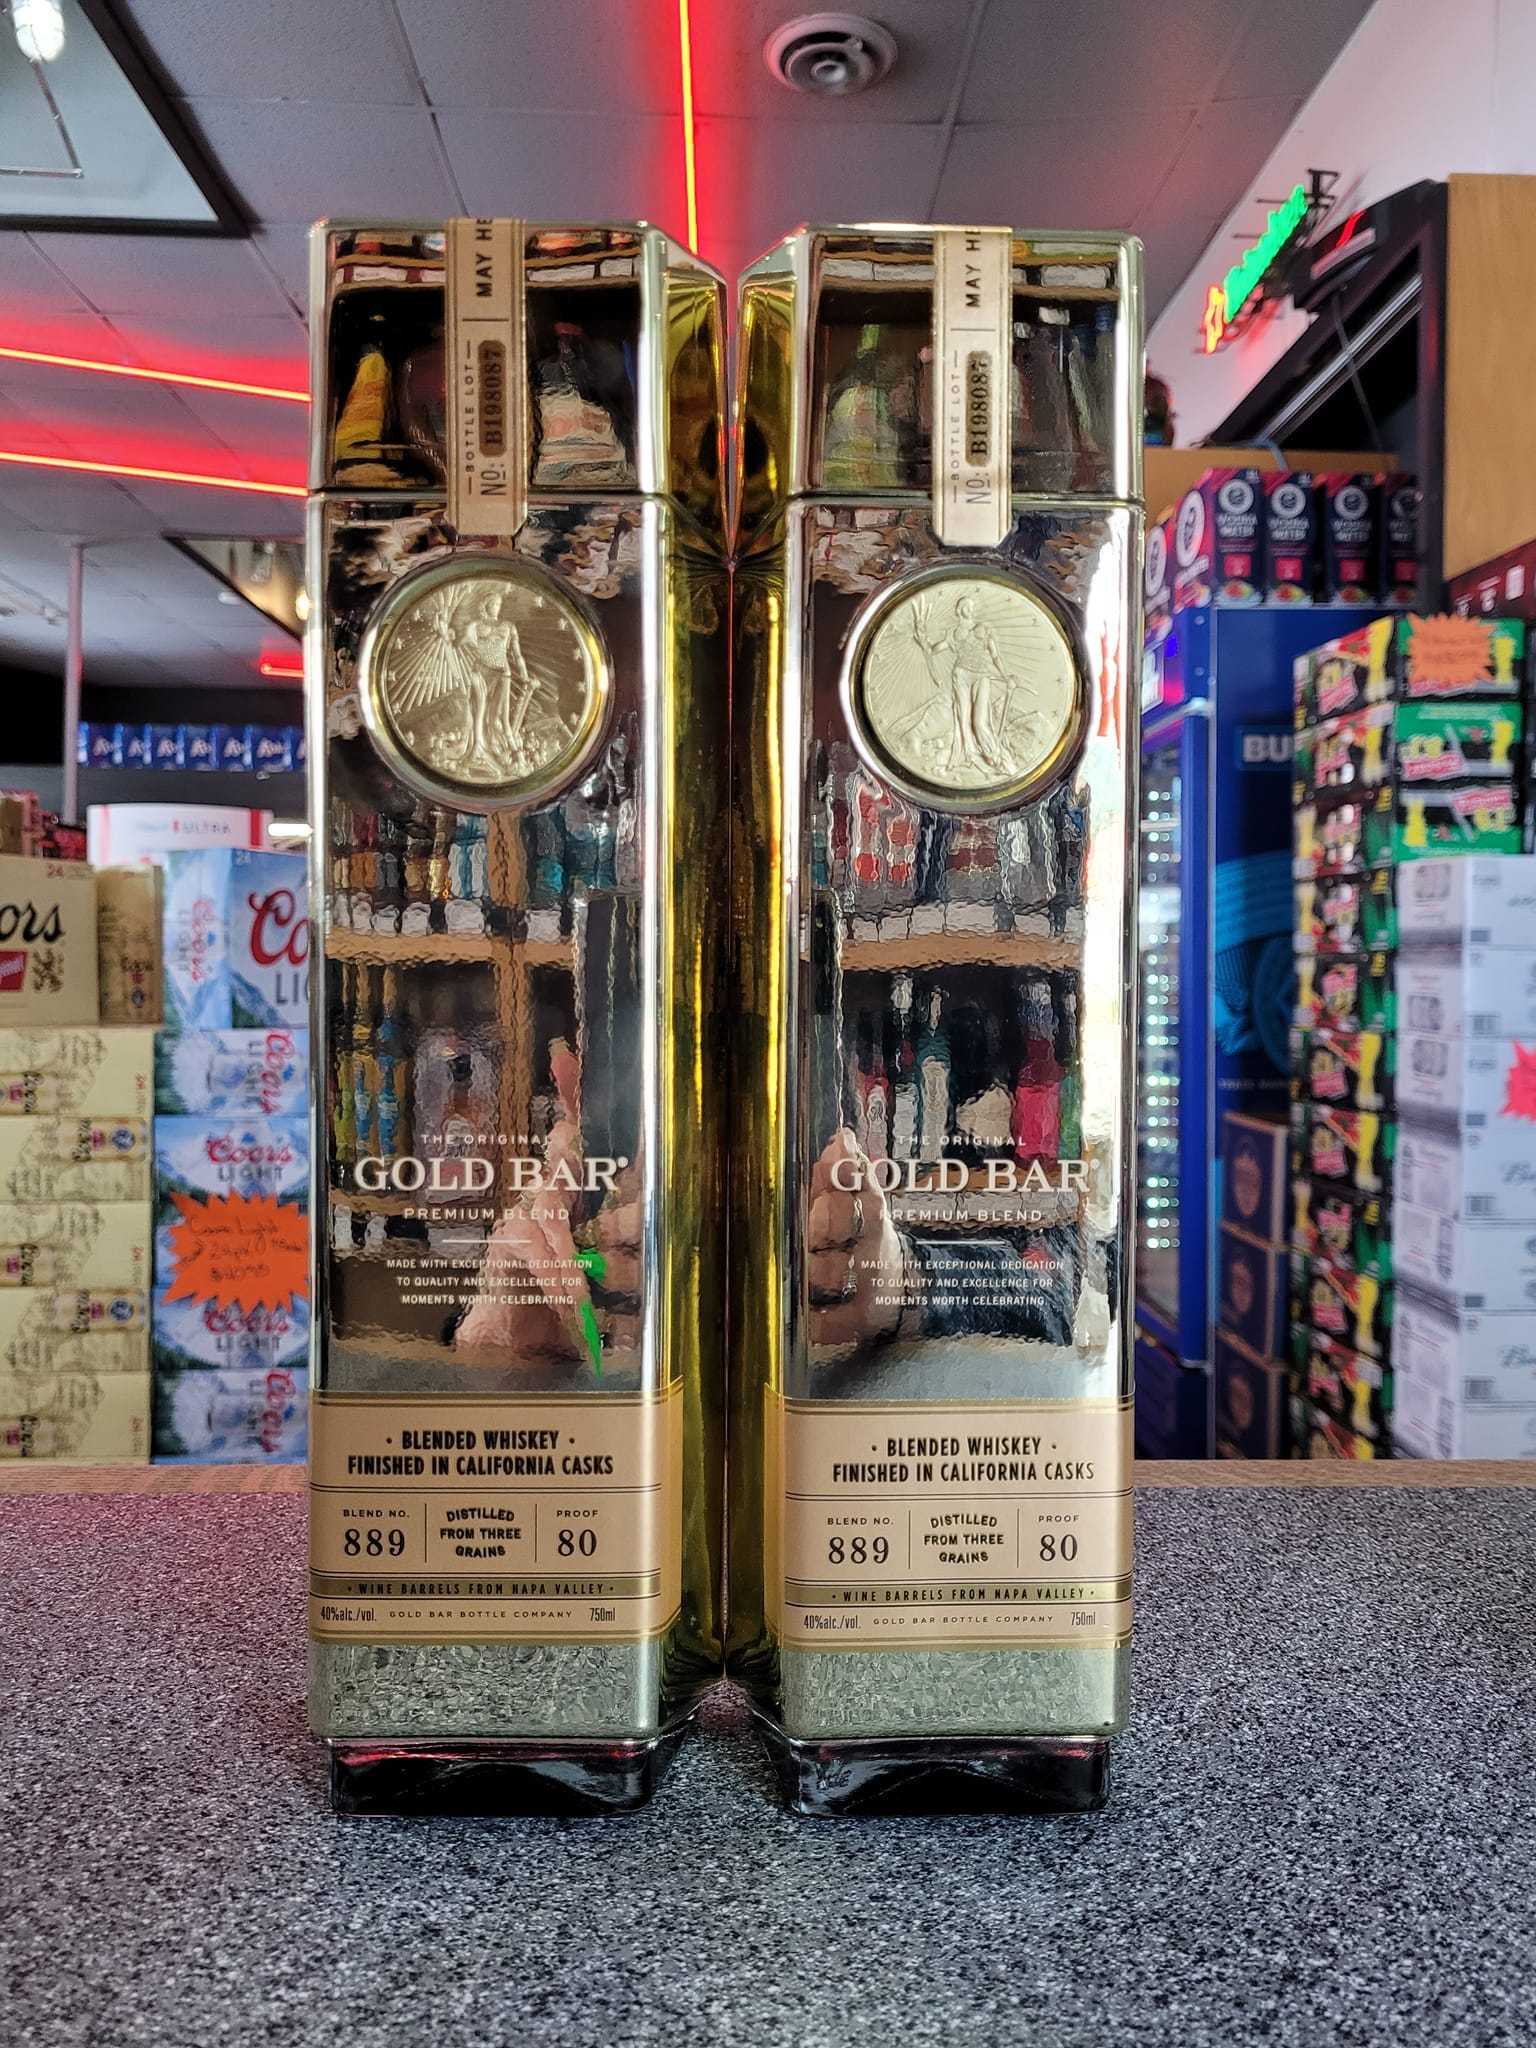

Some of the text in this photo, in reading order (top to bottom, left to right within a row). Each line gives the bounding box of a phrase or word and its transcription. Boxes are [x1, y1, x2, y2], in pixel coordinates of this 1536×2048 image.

[476, 252, 493, 297] MAY
[965, 231, 981, 308] MAY H
[465, 365, 475, 472] BOTTLE LOT
[950, 374, 960, 481] BOTTLE LOT
[421, 1134, 553, 1145] THE ORIGINAL
[900, 1136, 1026, 1146] THE ORIGINAL
[354, 1156, 495, 1191] GOLD
[831, 1159, 969, 1192] GOLD
[404, 1208, 569, 1220] PREMIUM BLEND
[880, 1210, 1042, 1221] PREMIUM BLEND
[387, 1259, 592, 1269] MADE WITH EXCEPTIONAL DEDICATION
[862, 1260, 1063, 1270] MADE WITH EXCEPTIONAL DEDICATION
[397, 1277, 582, 1287] TO QUALITY AND EXCELLENCE FOR
[872, 1278, 1053, 1288] TO QUALITY AND EXCELLENCE FOR
[402, 1295, 577, 1304] MOMENTS WORTH CELEBRATING.
[876, 1296, 1048, 1305] MOMENTS WORTH CELEBRATING.
[402, 1430, 560, 1450] BLENDED WHISKEY
[887, 1436, 1042, 1457] BLENDED WHISKEY
[348, 1455, 613, 1475] FINISHED IN CALIFORNIA CASKS
[833, 1462, 1094, 1483] FINISHED IN CALIFORNIA CASKS
[344, 1510, 410, 1518] BLEND NO.
[447, 1508, 514, 1523] DISTILLED
[557, 1510, 598, 1518] PROOF
[1039, 1515, 1079, 1523] PROOF
[827, 1517, 894, 1526] BLEND NO.
[930, 1514, 998, 1528] DISTILLED
[440, 1528, 521, 1539] FROM THREE
[924, 1534, 1004, 1546] FROM THREE
[344, 1529, 405, 1557] 889
[558, 1529, 597, 1557] 80
[1039, 1534, 1078, 1562] 80
[456, 1545, 506, 1558] GRAINS
[828, 1536, 889, 1564] 889
[939, 1551, 989, 1564] GRAINS
[359, 1583, 604, 1595] WINE BARRELS FROM NAPA VALLEY
[843, 1588, 1084, 1602] WINE BARRELS FROM NAPA VALLEY
[589, 1607, 615, 1622] 750ml
[943, 1616, 988, 1624] BOTTLE
[996, 1615, 1053, 1623] COMPANY
[1071, 1611, 1096, 1627] 750ml
